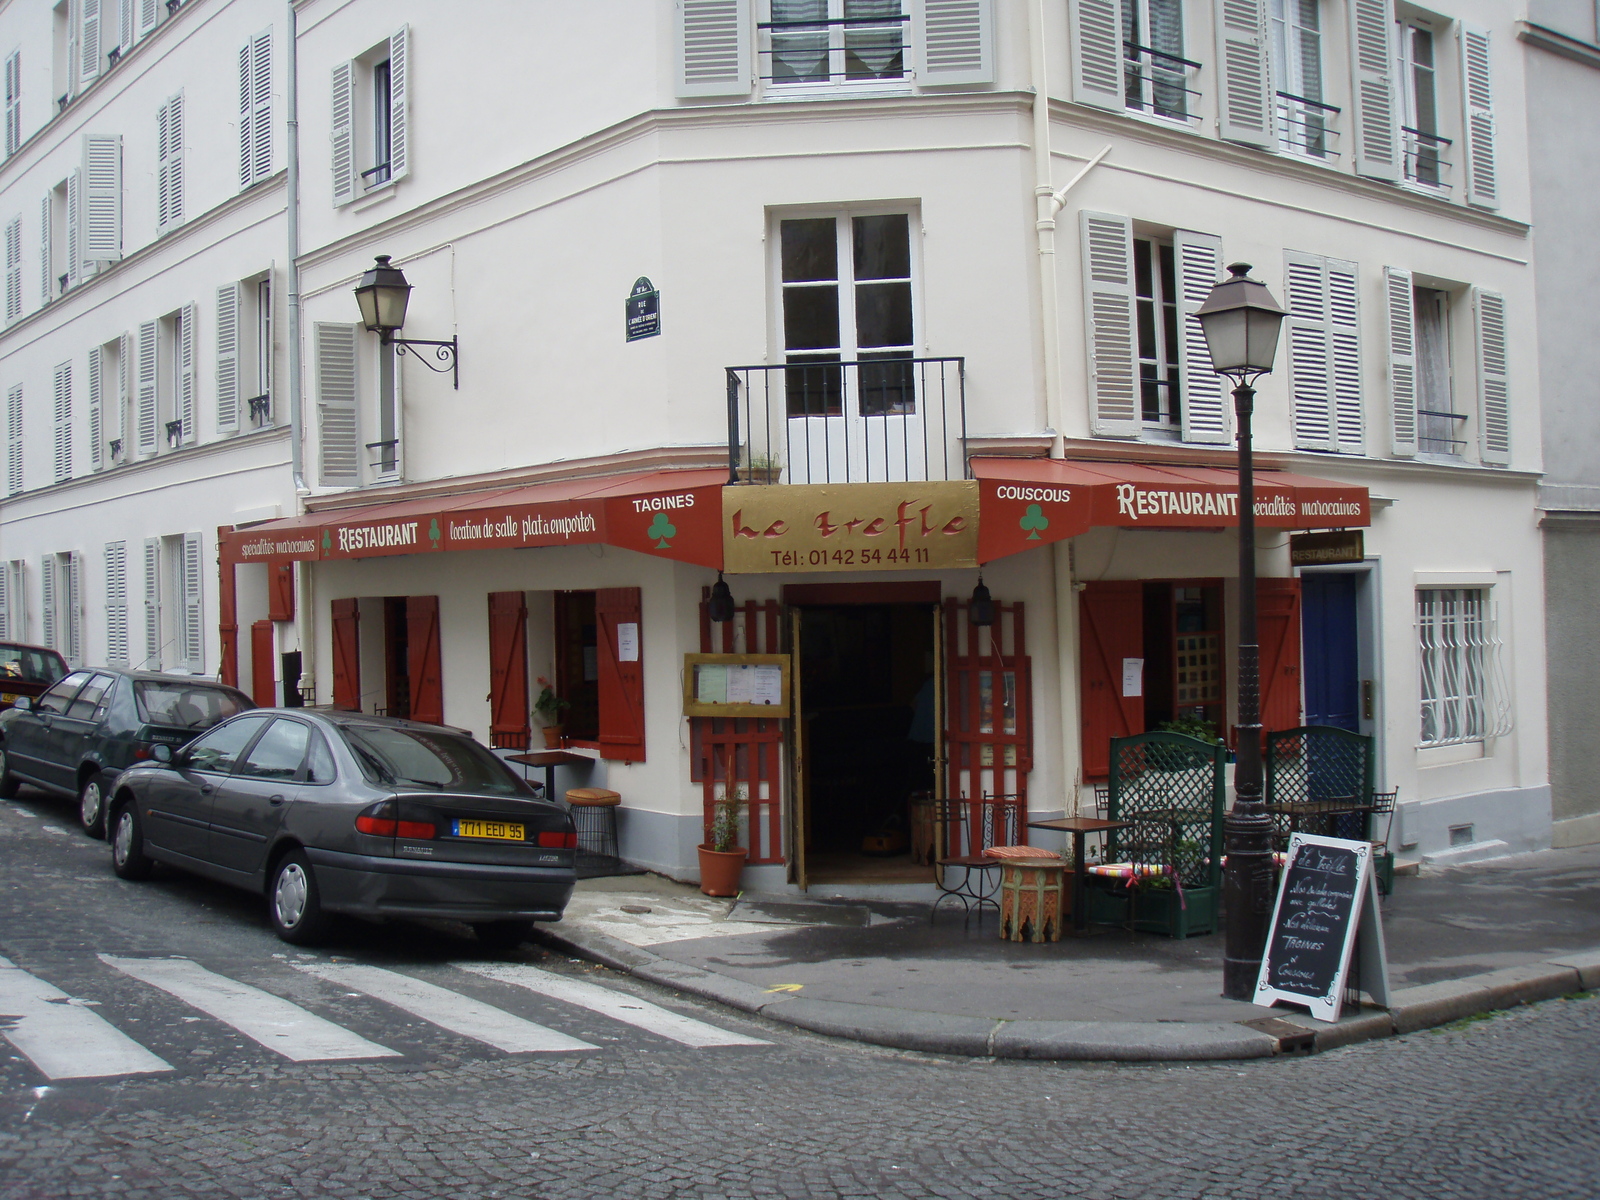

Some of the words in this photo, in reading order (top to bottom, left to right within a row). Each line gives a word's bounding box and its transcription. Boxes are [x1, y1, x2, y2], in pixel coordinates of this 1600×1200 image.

[632, 493, 695, 513] TAGINES
[996, 485, 1071, 503] COUSCOUS
[1116, 483, 1239, 520] RESTAURANT
[1253, 494, 1296, 517] écialités
[1301, 497, 1361, 516] marocaines
[449, 519, 482, 541] location
[482, 517, 494, 539] de
[495, 515, 518, 538] salle
[522, 513, 543, 542] plat
[543, 519, 550, 535] à
[550, 510, 596, 540] emporter
[241, 537, 275, 560] spécialités
[276, 535, 315, 554] marocaines
[338, 522, 418, 553] RESTAURANT
[770, 550, 804, 566] Tél:
[861, 549, 882, 564] 54
[887, 548, 910, 563] 44
[914, 547, 930, 563] 11
[1292, 546, 1356, 561] RESTAURANT
[461, 821, 482, 836] 771
[485, 822, 505, 837] EED
[509, 824, 522, 839] 95
[1282, 934, 1325, 951] TAGINES
